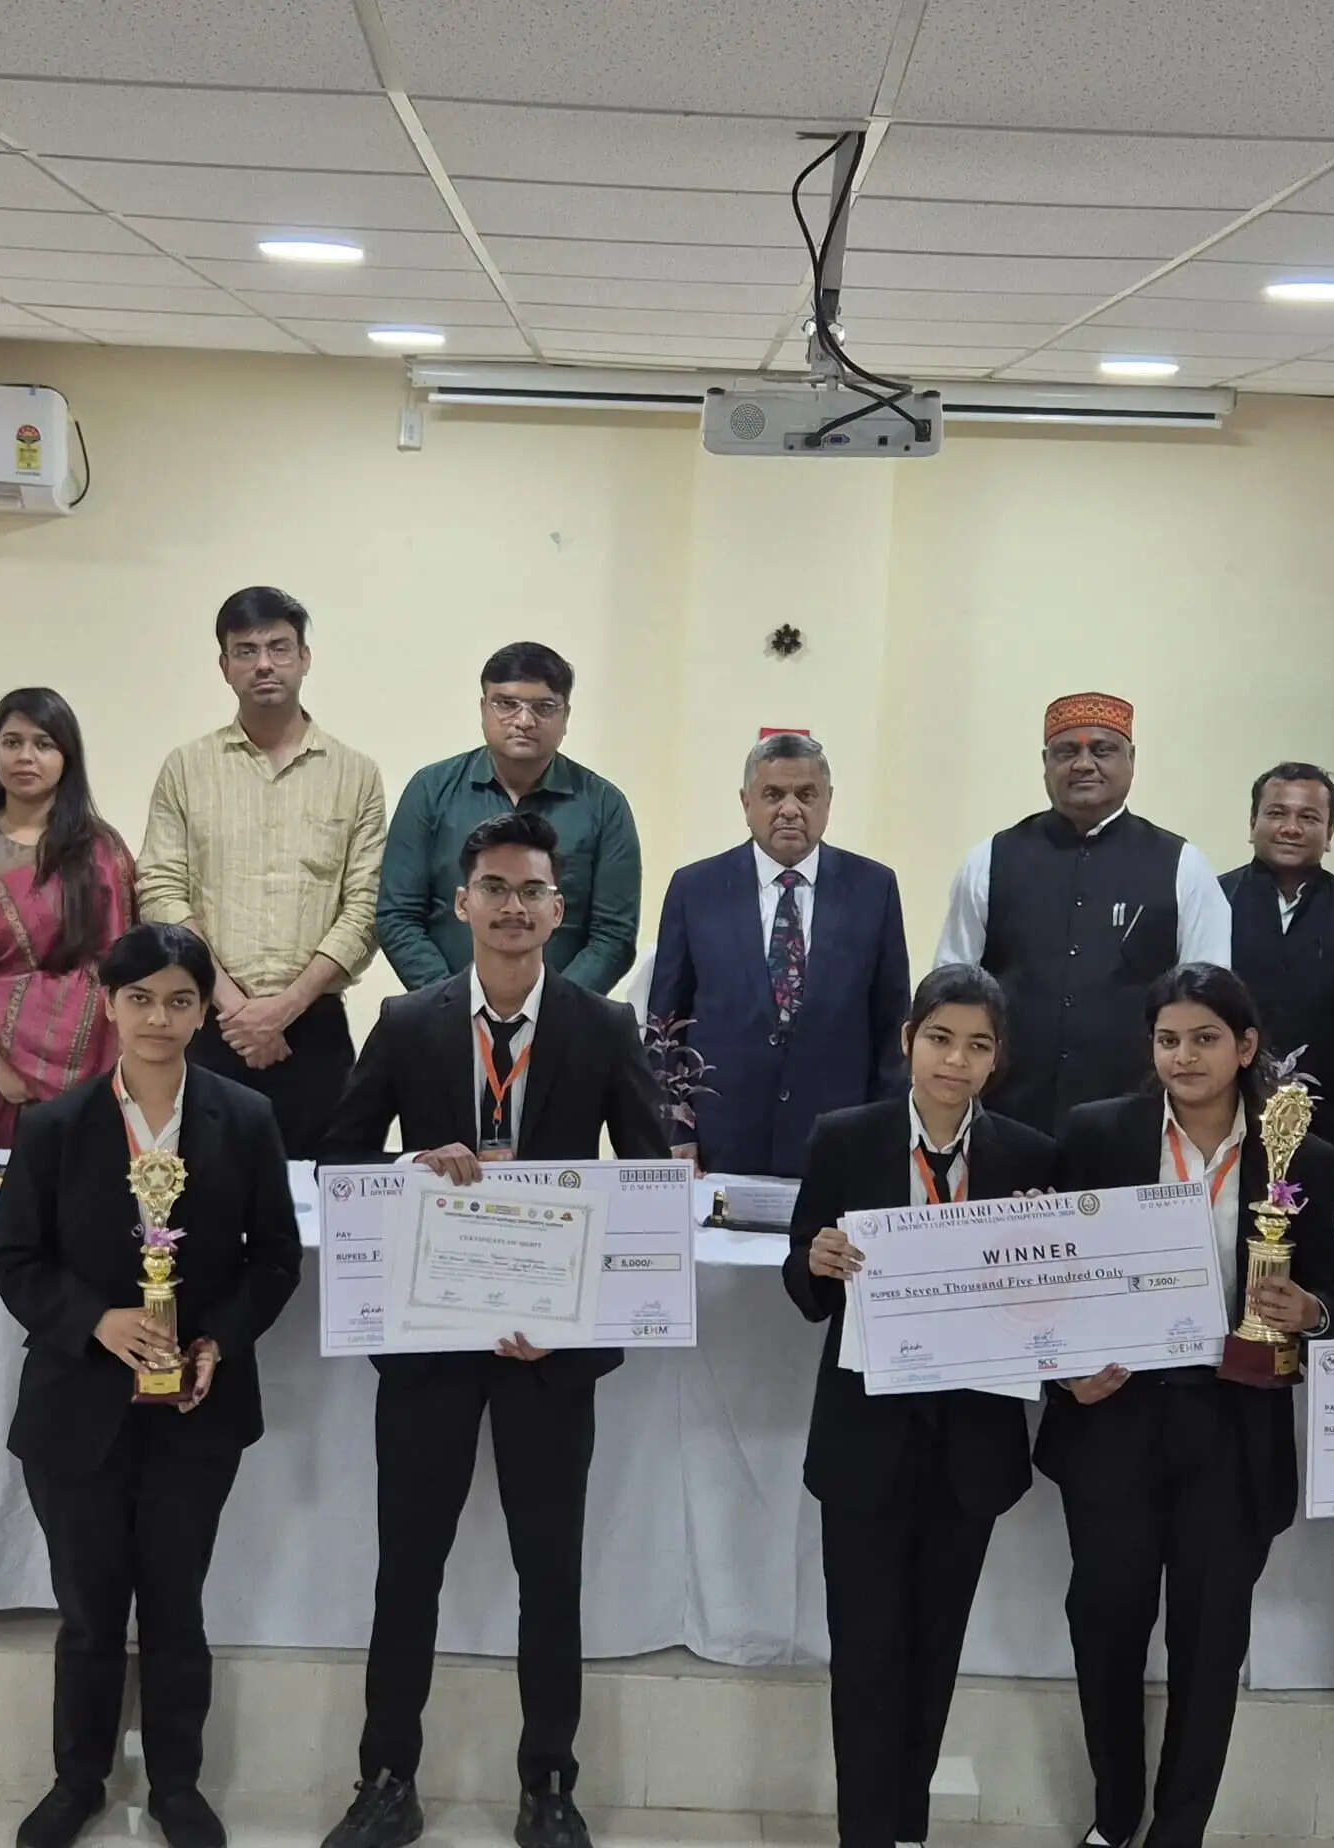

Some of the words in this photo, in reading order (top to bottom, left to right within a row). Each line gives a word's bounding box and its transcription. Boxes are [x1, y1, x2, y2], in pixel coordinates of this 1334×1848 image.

[897, 1211, 935, 1225] ATAL
[939, 1205, 992, 1221] BIHARI
[996, 1197, 1074, 1215] VAJPAYEE
[336, 1231, 351, 1239] PAY
[336, 1253, 368, 1261] RUPEES
[982, 1242, 1078, 1265] WINNER
[904, 1286, 940, 1297] Seven
[943, 1278, 1004, 1294] Thousand
[1007, 1276, 1033, 1289] Five
[1037, 1269, 1091, 1285] Hundred
[1095, 1267, 1124, 1280] Only
